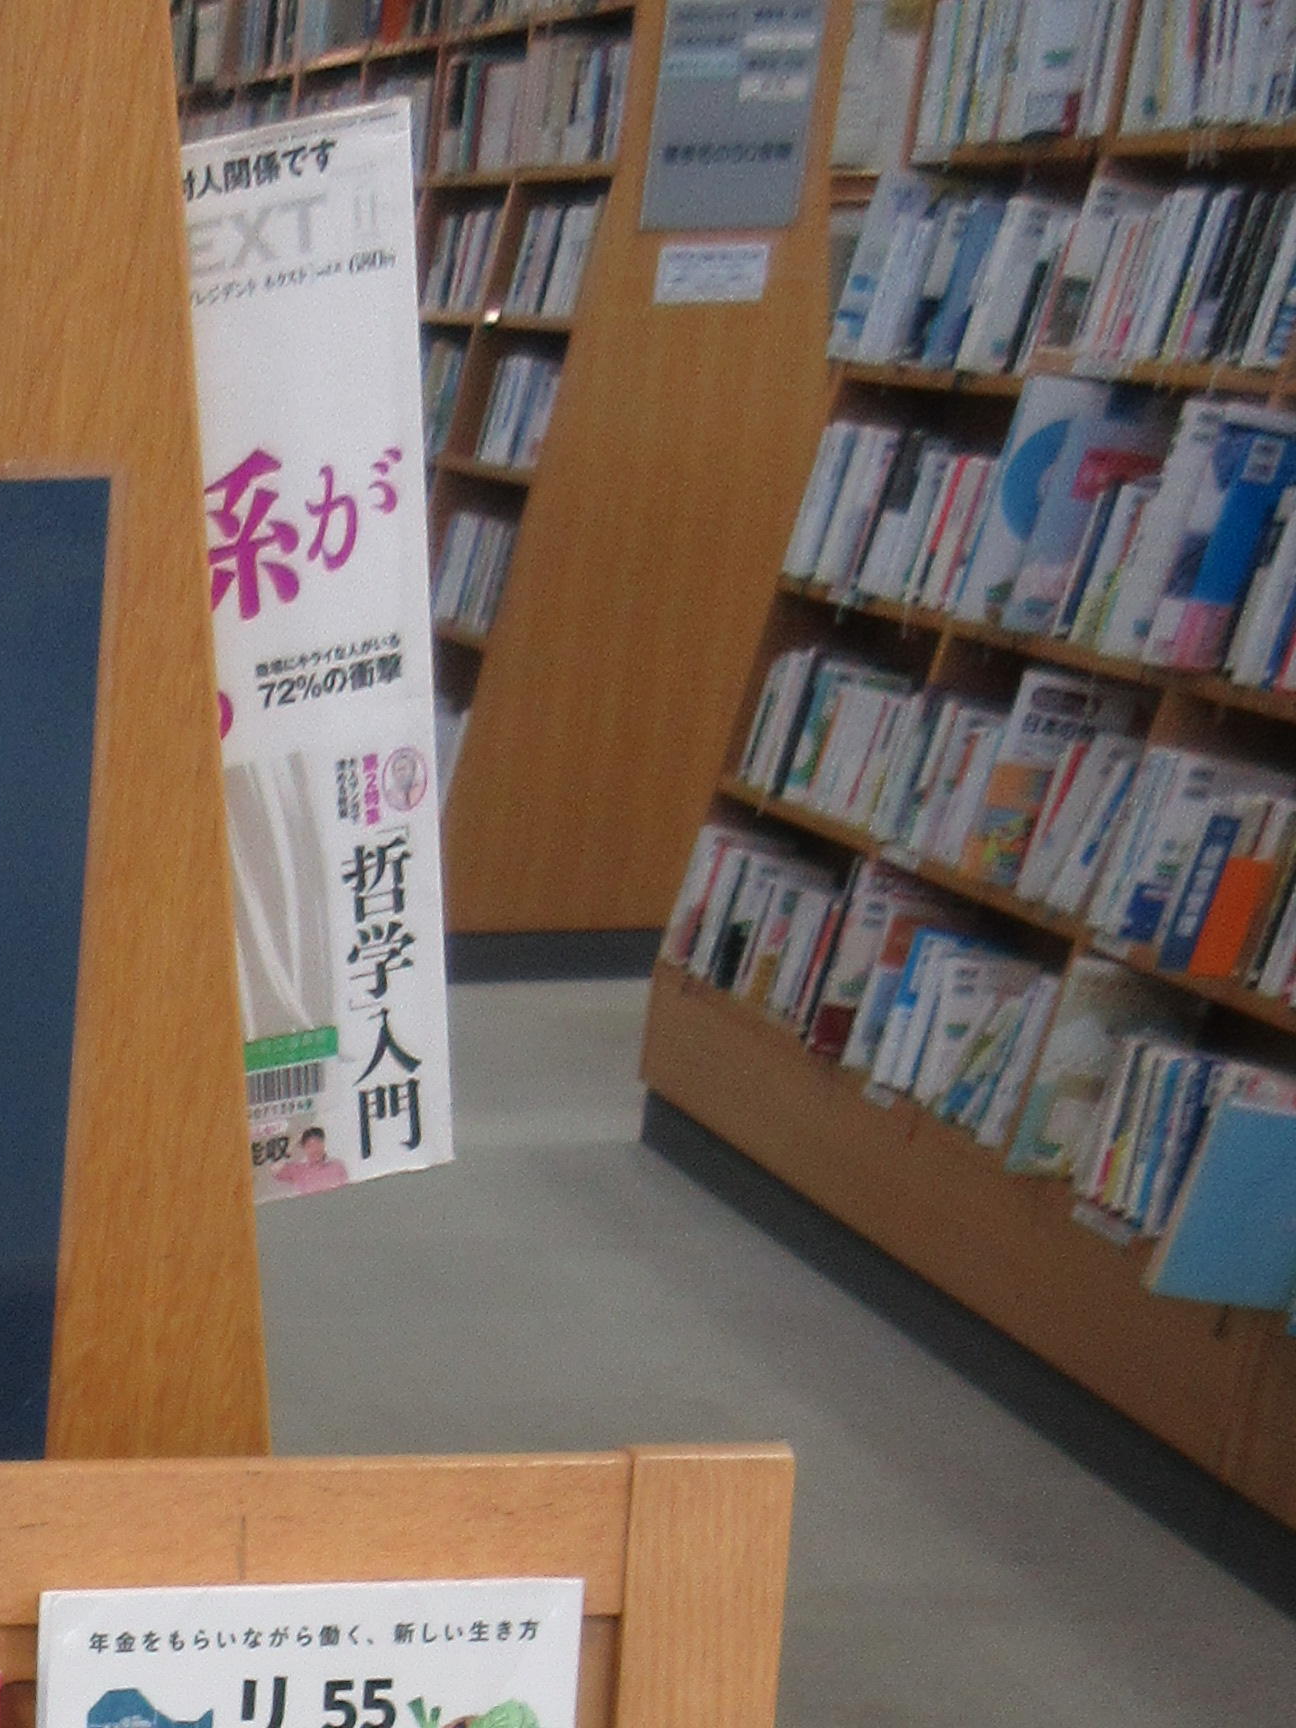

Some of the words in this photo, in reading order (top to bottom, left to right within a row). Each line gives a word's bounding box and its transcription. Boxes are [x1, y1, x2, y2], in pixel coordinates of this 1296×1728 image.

[88, 1619, 541, 1655] 年金をもらいながら働く、新しい生き方
